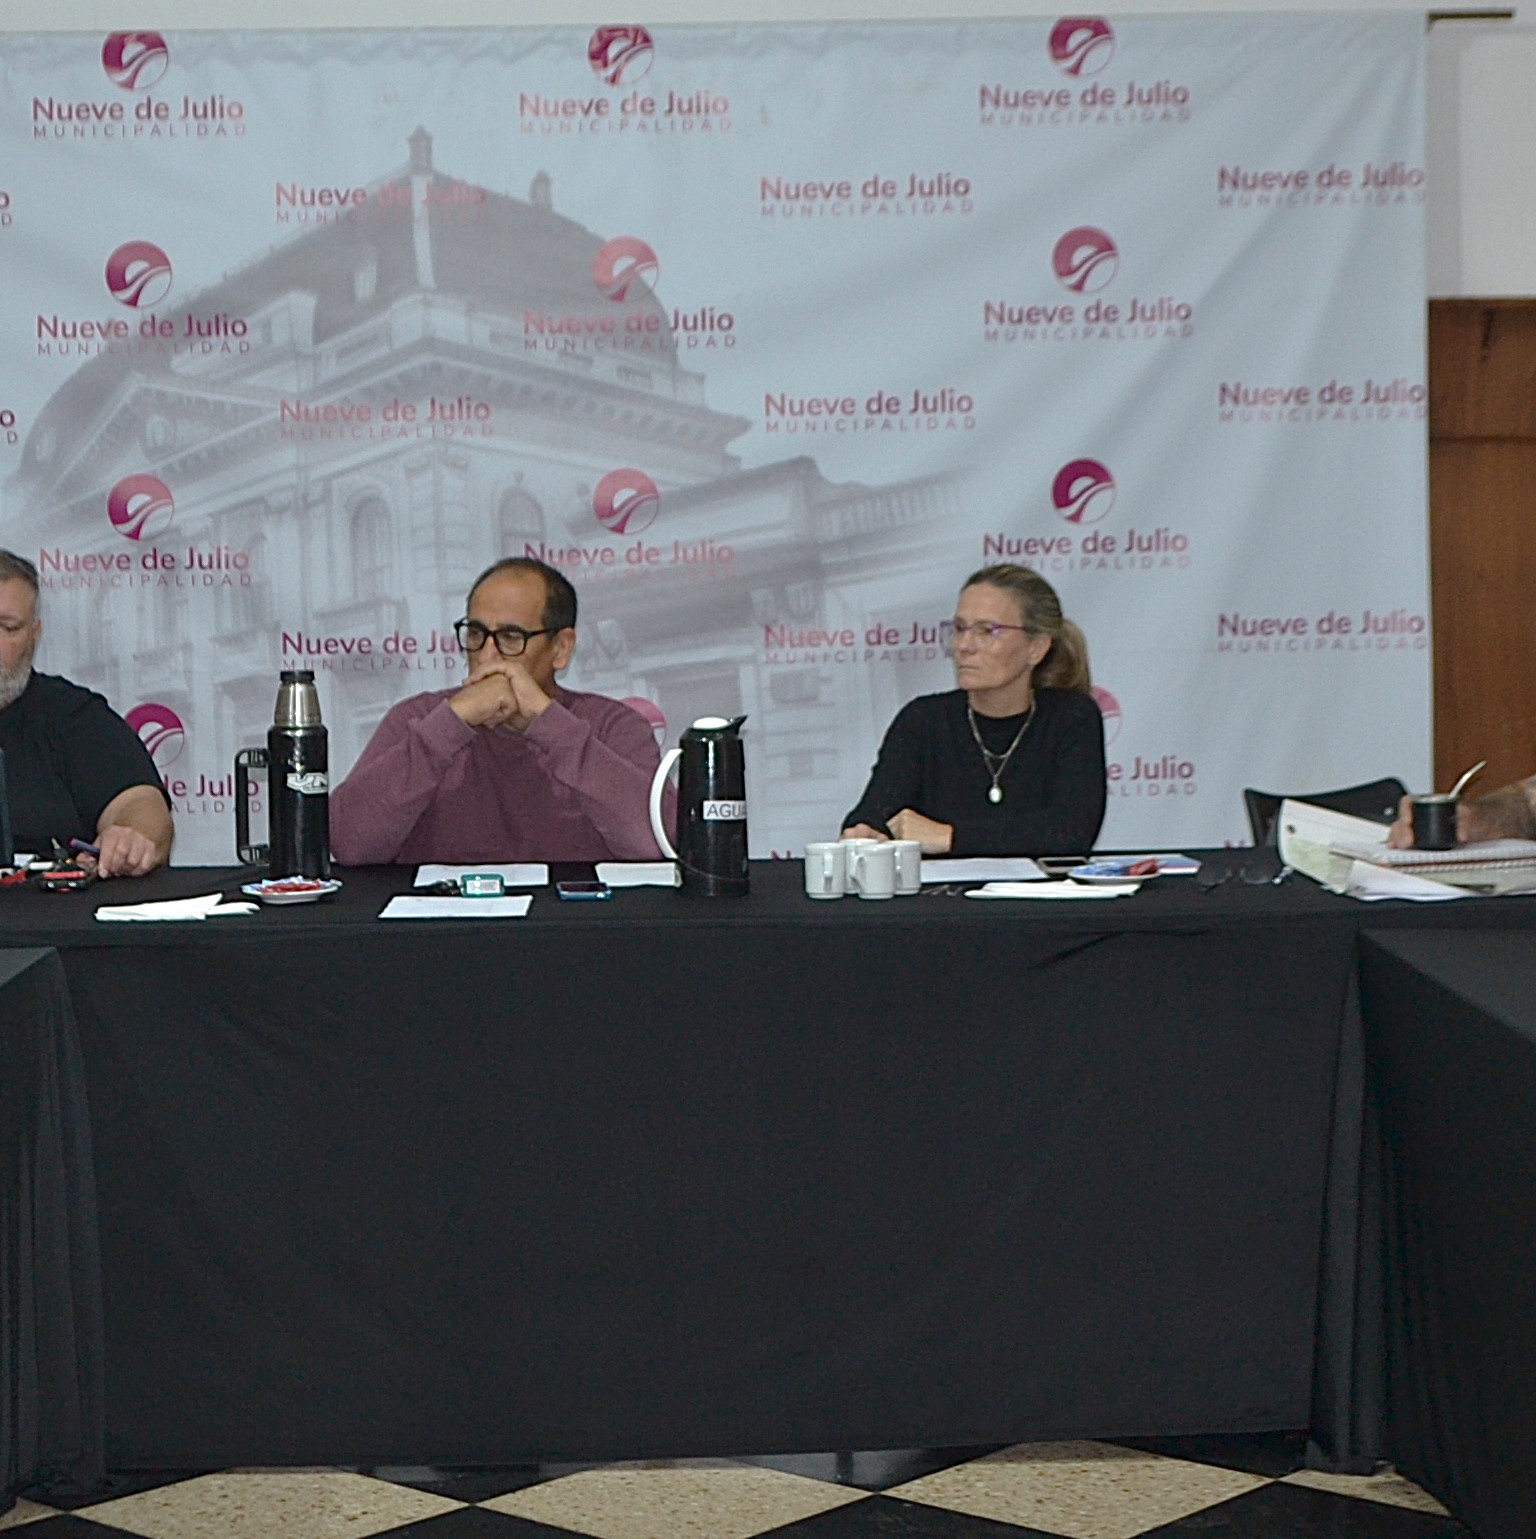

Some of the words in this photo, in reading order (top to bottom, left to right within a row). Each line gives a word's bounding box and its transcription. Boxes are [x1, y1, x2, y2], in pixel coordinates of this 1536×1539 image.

[33, 96, 124, 120] Nueve
[135, 95, 169, 120] de
[179, 94, 243, 120] Julio
[520, 93, 609, 117] Nueve
[621, 91, 655, 115] de
[665, 90, 729, 117] Julio
[981, 84, 1071, 109] Nueve
[1080, 82, 1115, 107] de
[1125, 80, 1190, 107] Julio
[34, 123, 245, 138] MUNICIPALIDAD
[761, 177, 852, 201] Nueve
[862, 174, 896, 198] de
[906, 172, 971, 198] Julio
[1219, 165, 1309, 191] Nueve
[1317, 163, 1352, 188] de
[1362, 162, 1424, 187] Julio
[276, 183, 366, 207] Nueve
[524, 310, 614, 334] Nueve
[624, 309, 660, 333] de
[670, 307, 734, 331] Julio
[984, 301, 1074, 325] Nueve
[1084, 299, 1119, 324] de
[1128, 297, 1191, 323] Julio
[37, 315, 128, 338] Nueve
[139, 314, 174, 337] de
[183, 314, 247, 337] Julio
[525, 335, 735, 350] MUNICIPALIDAD
[765, 393, 856, 416] Nueve
[866, 390, 900, 415] de
[909, 389, 974, 414] Julio
[1219, 382, 1310, 406] Nueve
[1318, 379, 1353, 404] de
[280, 399, 371, 423] Nueve
[382, 397, 416, 422] de
[427, 396, 491, 421] Julio
[767, 417, 975, 432] MUNICIPALIDAD
[625, 541, 660, 564] de
[670, 539, 734, 564] Julio
[984, 532, 1072, 556] Nueve
[1082, 530, 1116, 553] de
[1124, 528, 1188, 553] Julio
[40, 548, 130, 572] Nueve
[141, 547, 175, 571] de
[184, 546, 249, 570] Julio
[41, 573, 251, 588] MUNICIPALIDAD
[765, 624, 854, 648] Nueve
[866, 623, 899, 646] de
[1218, 614, 1307, 637] Nueve
[1317, 611, 1351, 634] de
[282, 632, 372, 655] Nueve
[383, 631, 417, 653] de
[284, 658, 467, 670] MUNICIPALID
[1106, 763, 1122, 780] e
[1131, 756, 1195, 780] Julio
[196, 774, 259, 797] Julo
